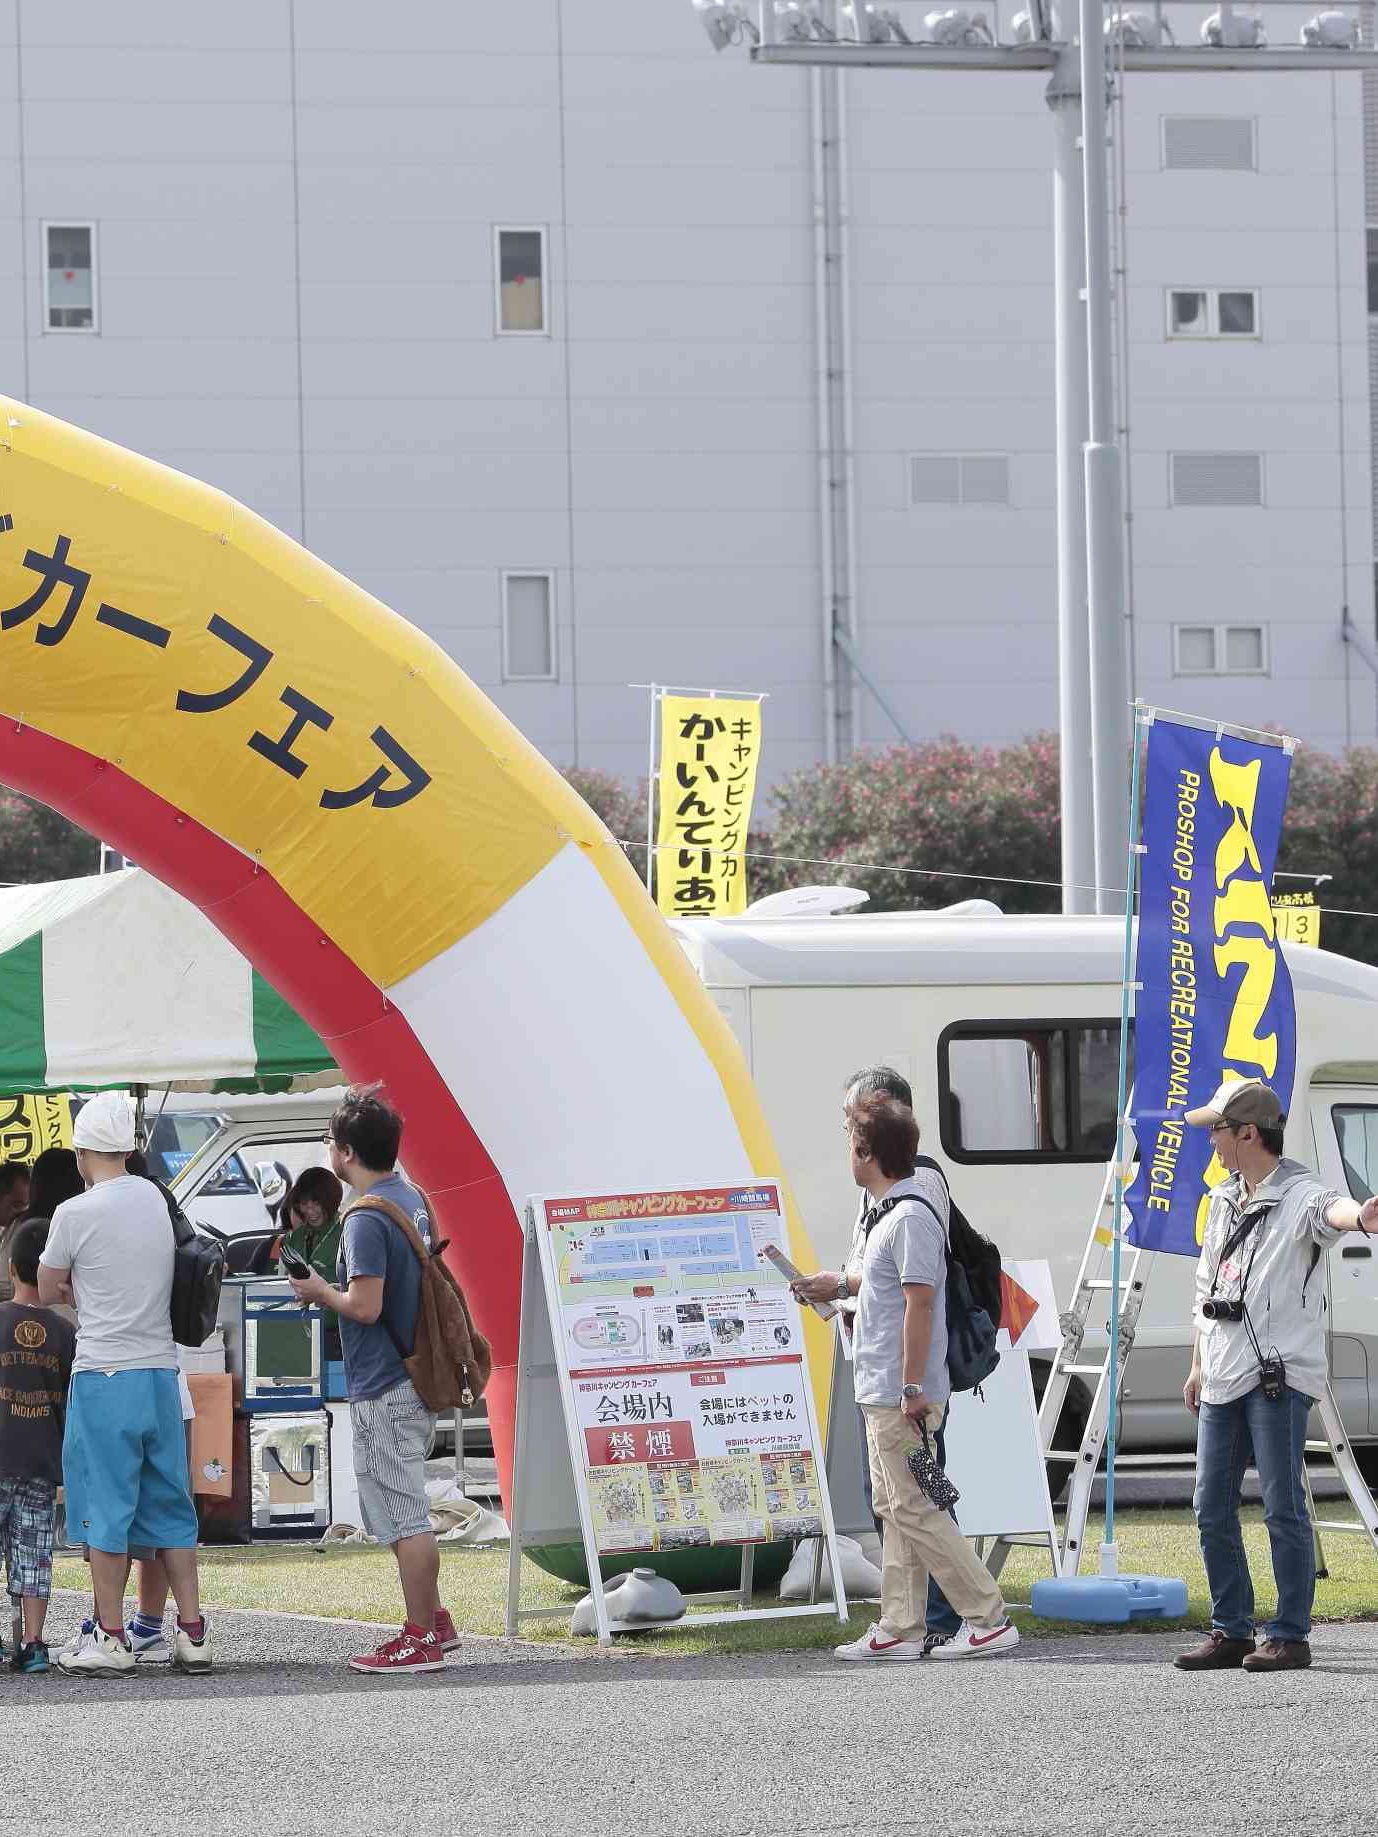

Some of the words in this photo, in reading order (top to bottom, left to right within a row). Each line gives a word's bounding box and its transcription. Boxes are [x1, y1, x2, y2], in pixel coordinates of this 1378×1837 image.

[721, 717, 752, 902] キャンピングカー
[1173, 768, 1201, 881] PROSHOP
[1170, 885, 1191, 935] FOR
[1165, 938, 1198, 1110] RECREATIONAL
[1146, 1119, 1185, 1213] VEHICLE
[595, 1391, 673, 1423] 会場内
[700, 1393, 795, 1412] 会場にはペットの
[702, 1411, 797, 1427] 入場ができません
[607, 1428, 675, 1461] 禁煙
